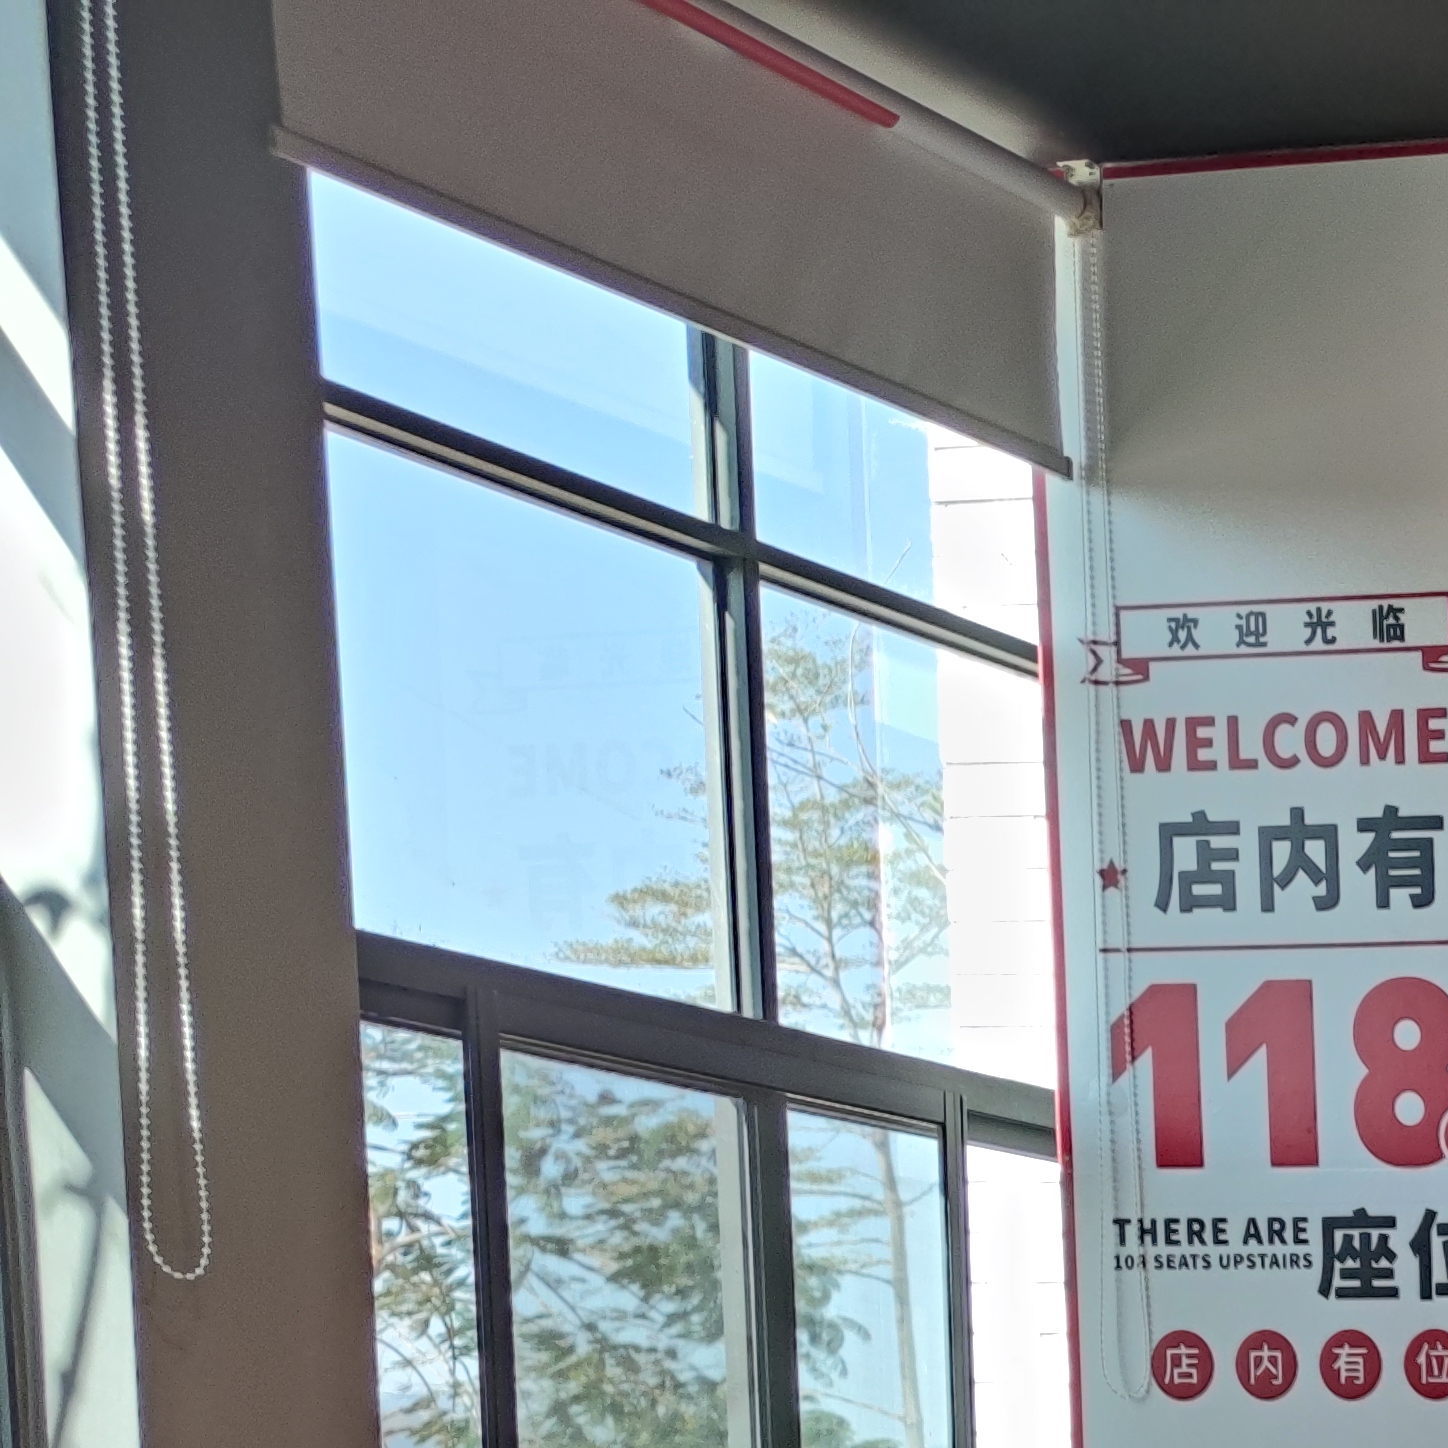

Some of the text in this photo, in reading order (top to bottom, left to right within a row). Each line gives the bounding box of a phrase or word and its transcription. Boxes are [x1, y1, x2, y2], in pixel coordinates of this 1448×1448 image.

[1167, 604, 1406, 651] 欢迎光临
[1153, 805, 1445, 914] 店内有
[1112, 1216, 1310, 1247] THERE ARE
[1153, 1253, 1212, 1271] SEATS
[1218, 1253, 1314, 1270] UPSTAIRS
